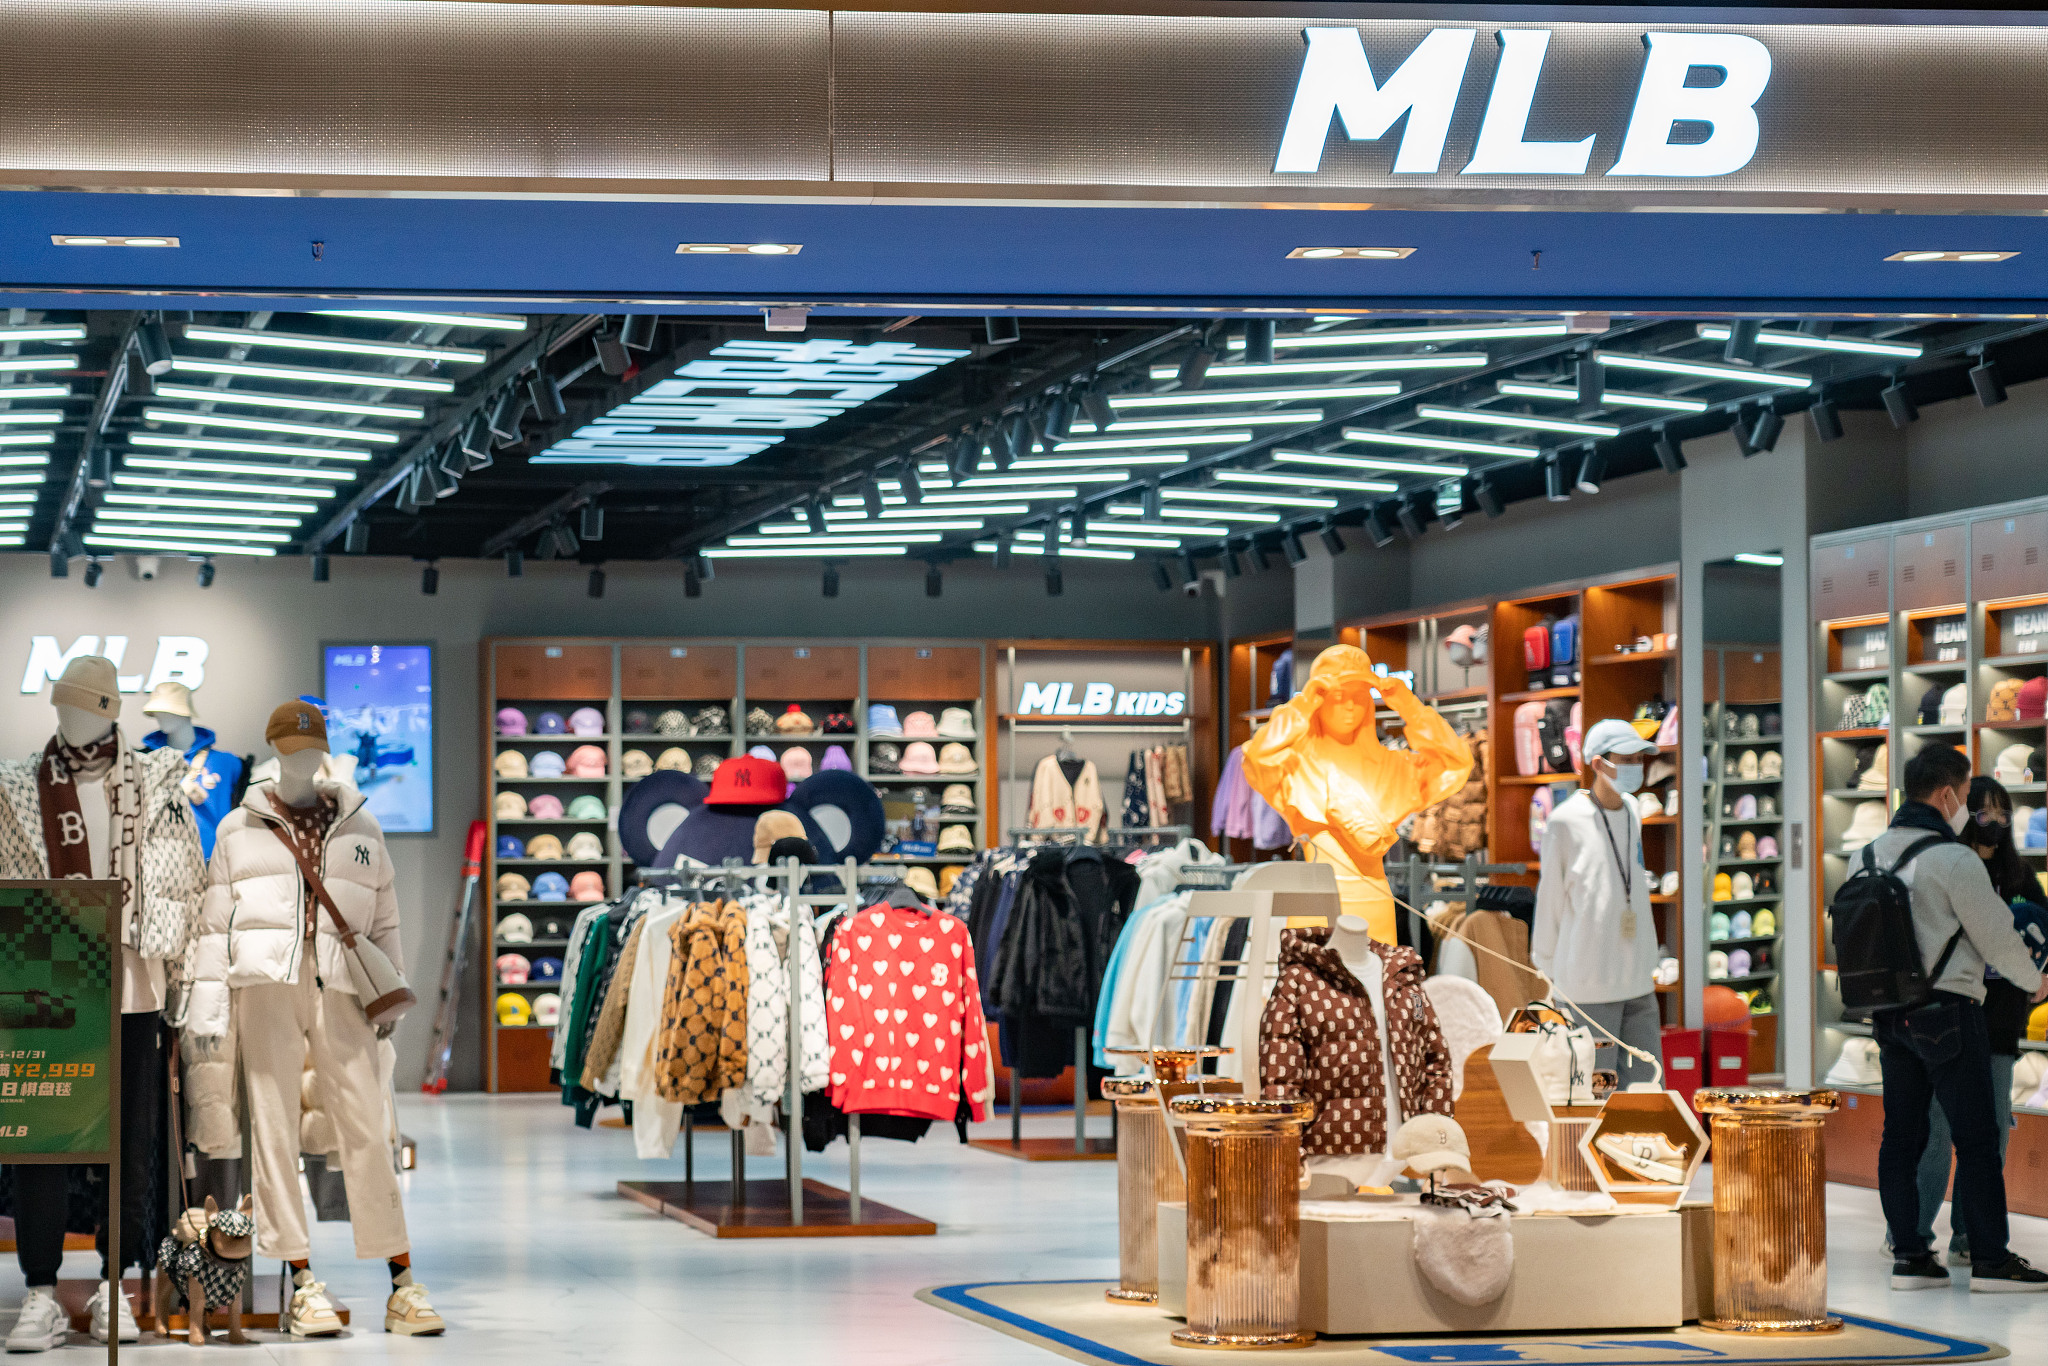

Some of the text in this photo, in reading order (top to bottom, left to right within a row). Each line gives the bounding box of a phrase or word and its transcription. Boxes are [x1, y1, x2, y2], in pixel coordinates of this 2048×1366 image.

[1271, 26, 1772, 177] MLB
[20, 635, 209, 694] MLB
[1017, 682, 1186, 716] MLB KIDS
[57, 811, 85, 846] B
[13, 1063, 96, 1079] ¥2,999
